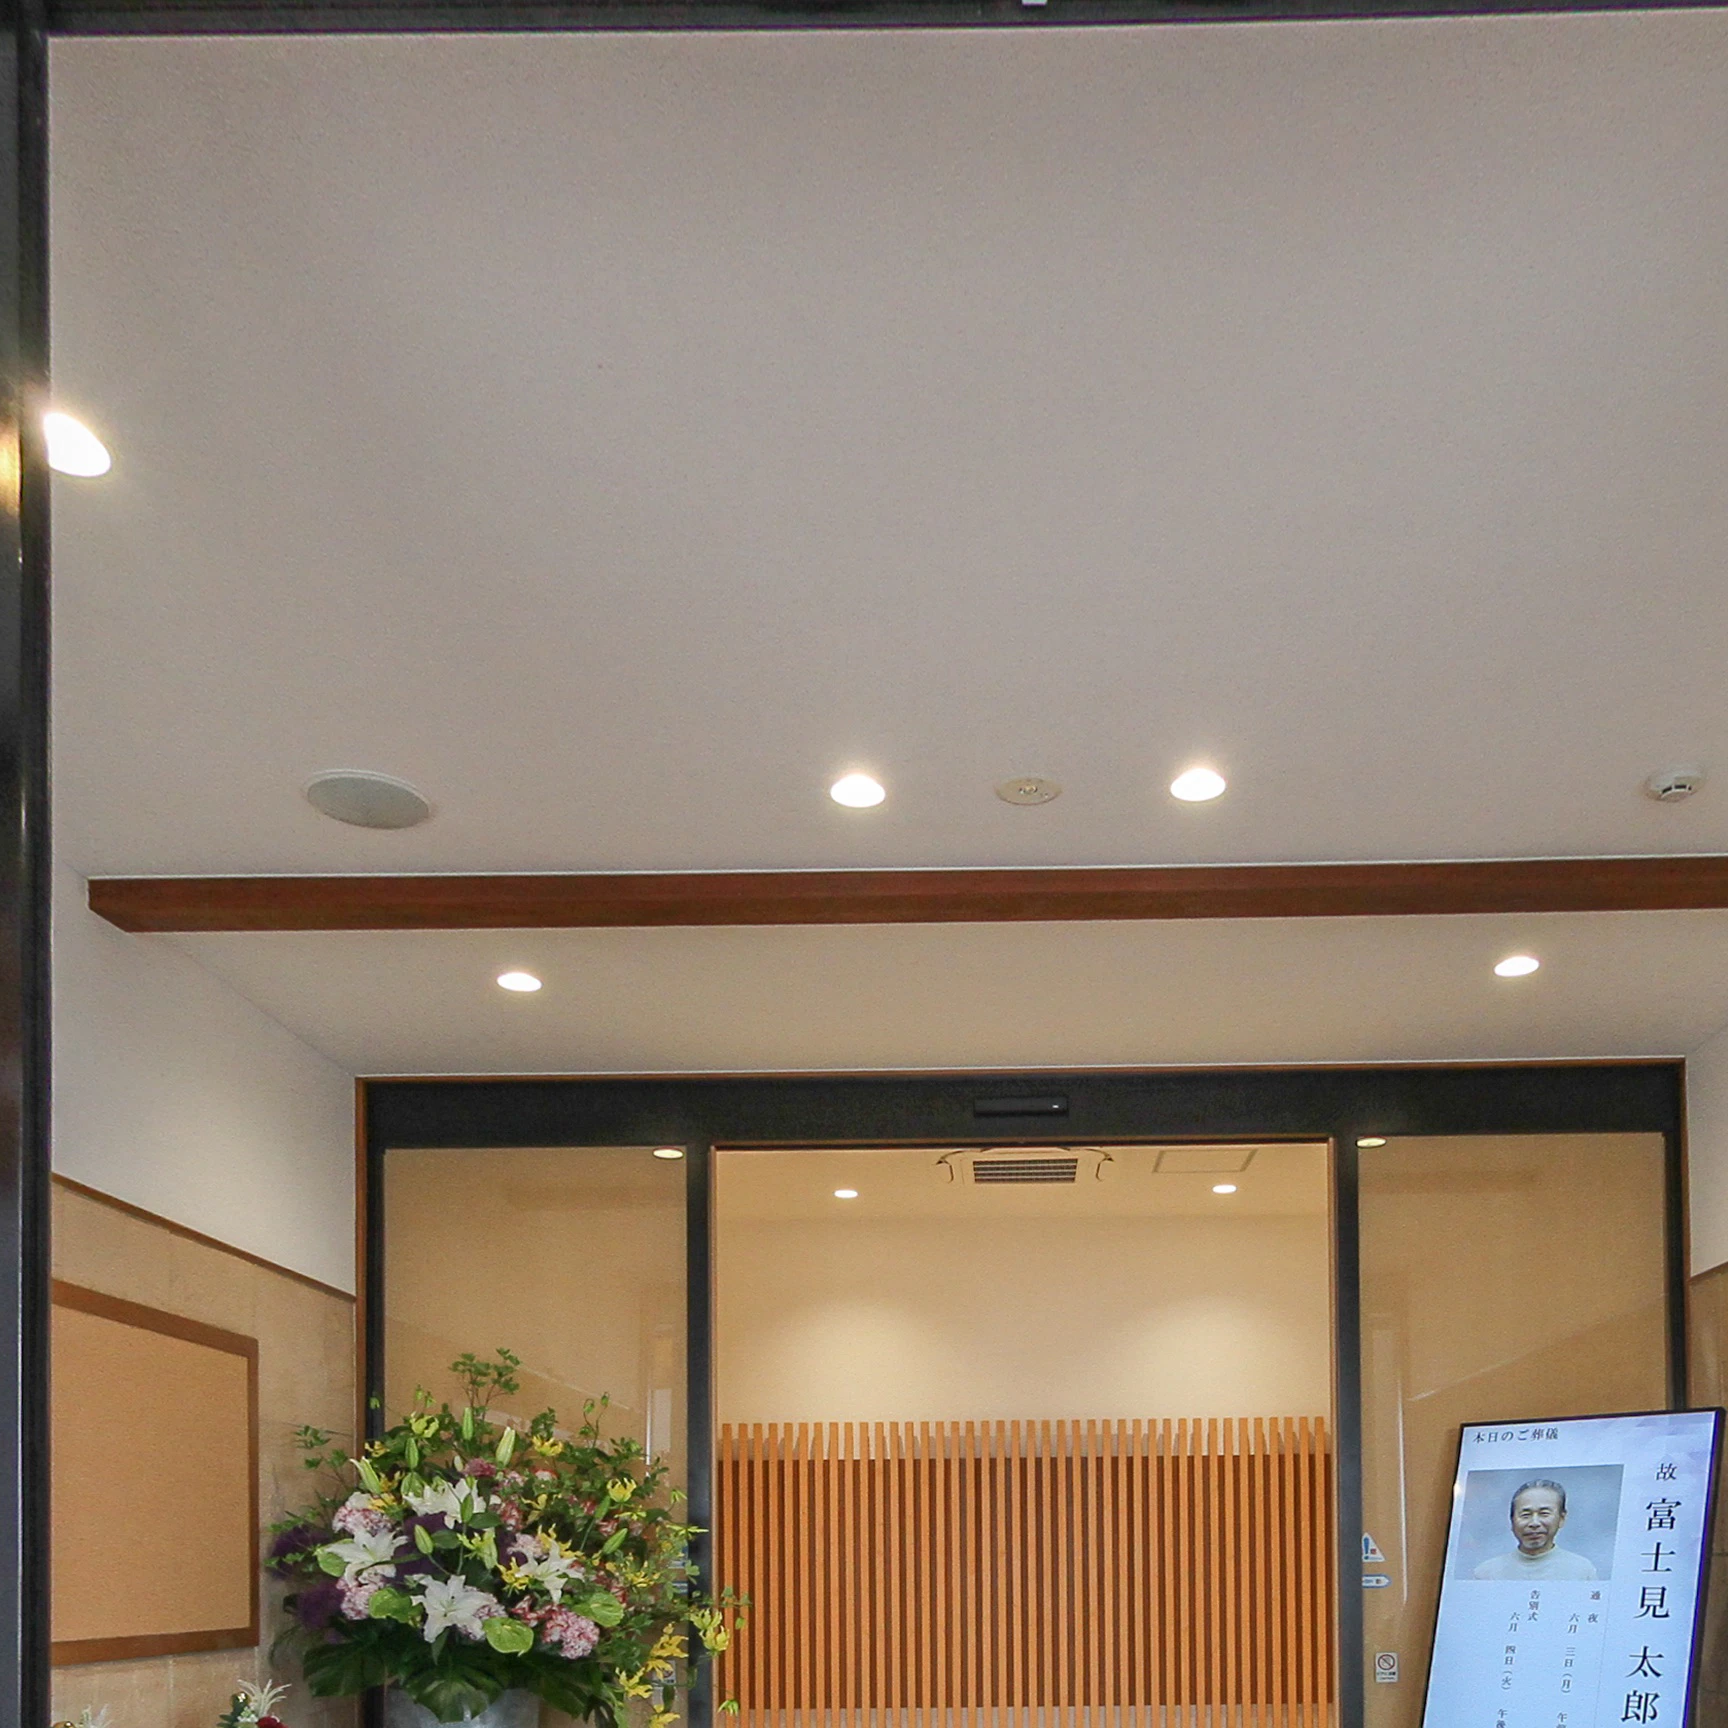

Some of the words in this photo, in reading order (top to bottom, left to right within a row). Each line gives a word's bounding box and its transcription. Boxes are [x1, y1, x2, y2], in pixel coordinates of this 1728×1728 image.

[1472, 1427, 1560, 1444] 本日のご葬儀
[1656, 1463, 1678, 1482] 故
[1634, 1498, 1682, 1620] 富士見
[1527, 1590, 1540, 1622] 告別式
[1621, 1646, 1665, 1725] 太郎
